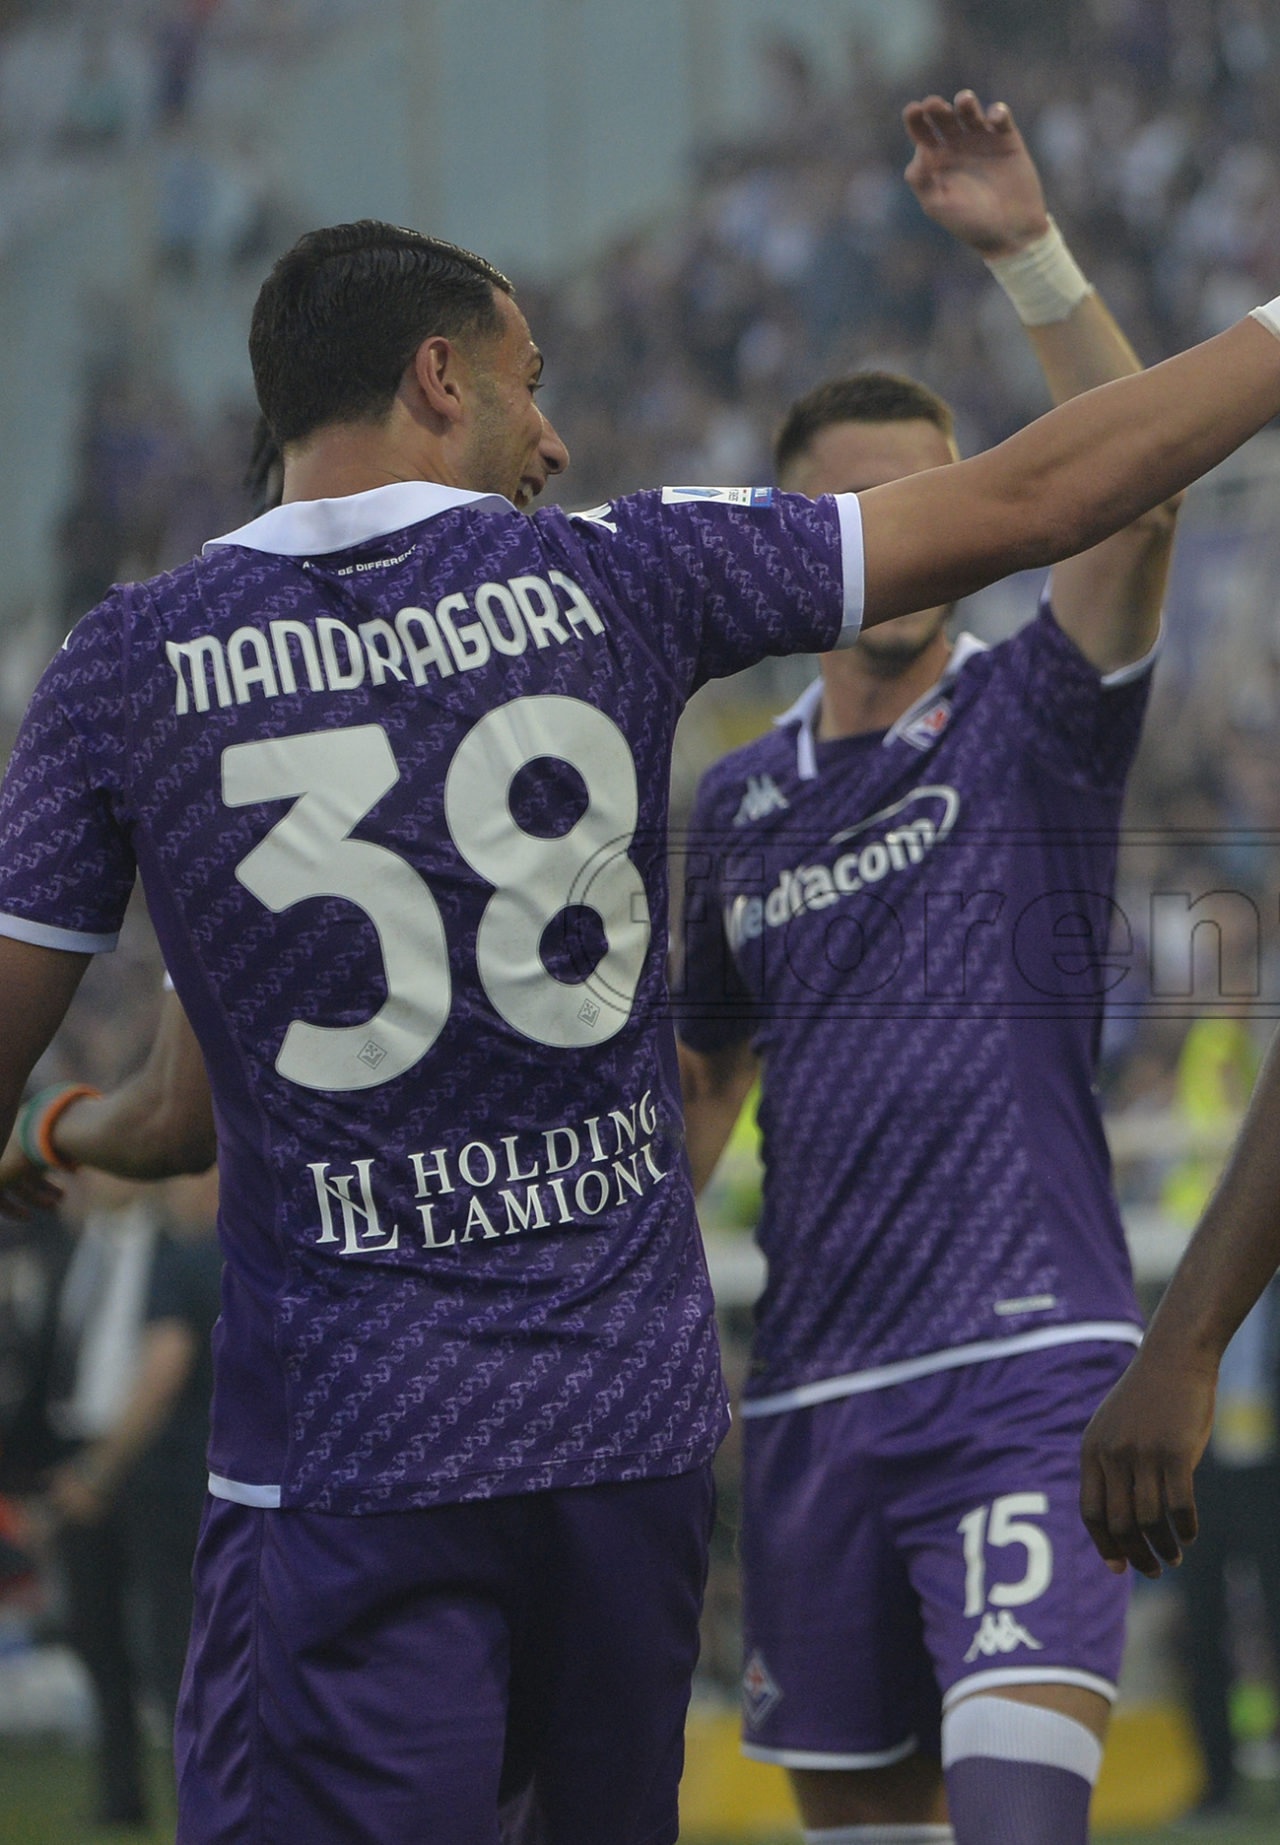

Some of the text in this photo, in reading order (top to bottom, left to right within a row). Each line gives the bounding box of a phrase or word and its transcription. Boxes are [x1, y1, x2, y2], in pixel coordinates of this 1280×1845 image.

[356, 544, 417, 572] DIFFERENT
[165, 569, 605, 716] MANDRAGORA
[221, 694, 651, 1091] 38
[407, 1089, 656, 1198] HOLDING
[416, 1143, 668, 1249] LAMIONI
[958, 1491, 1053, 1618] 15
